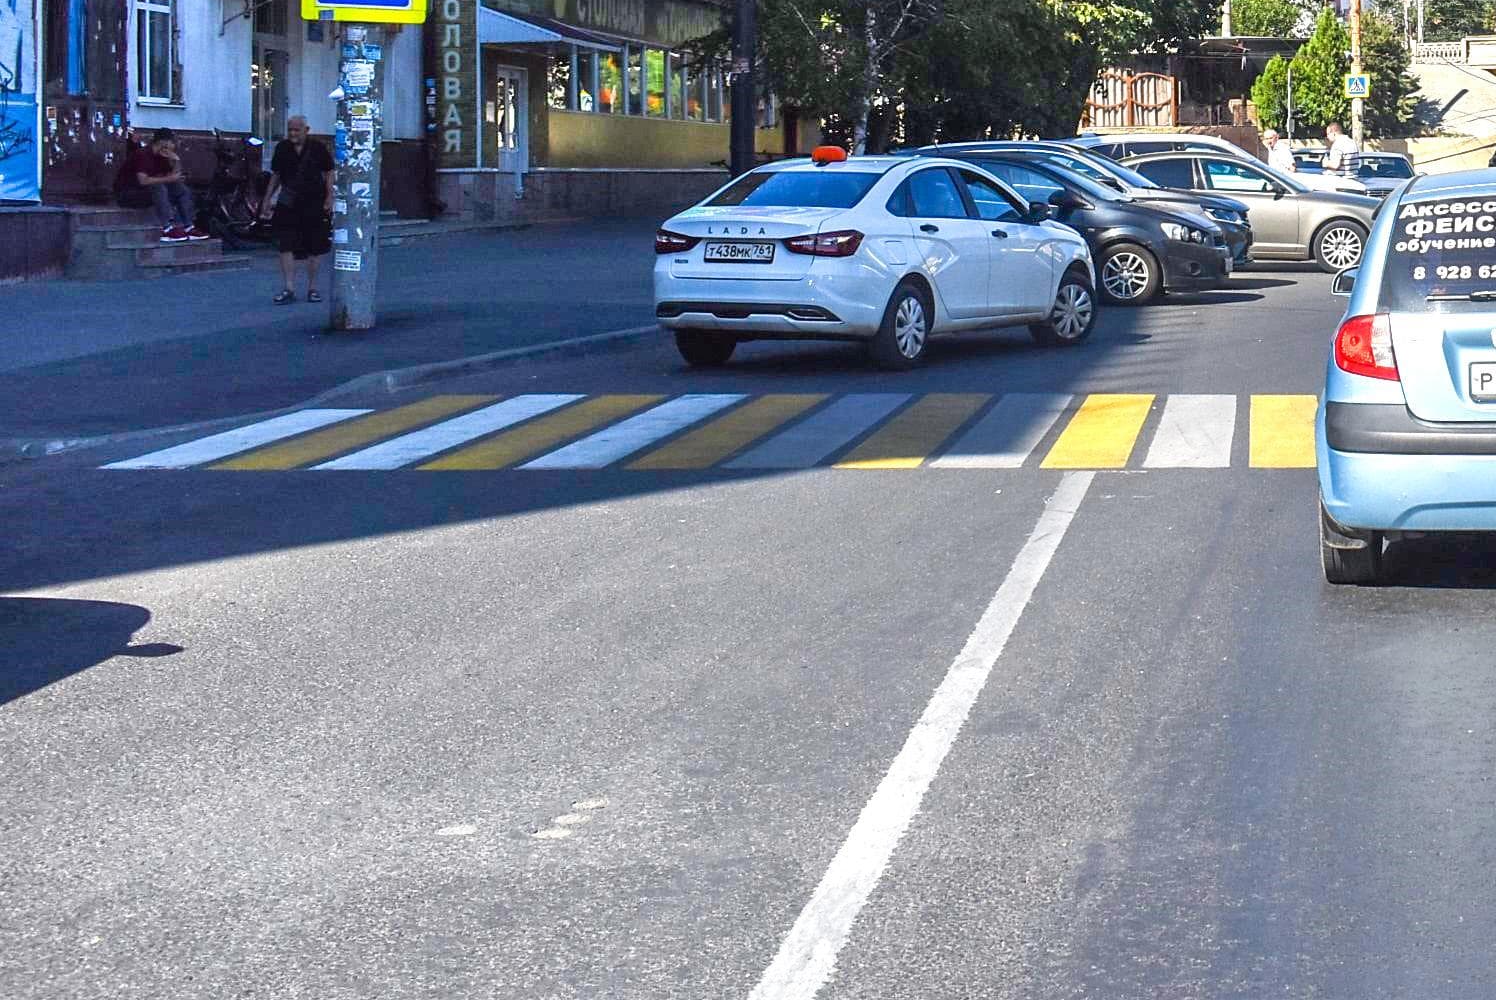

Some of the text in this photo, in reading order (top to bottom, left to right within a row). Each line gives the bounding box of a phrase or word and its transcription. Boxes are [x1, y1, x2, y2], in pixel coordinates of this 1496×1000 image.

[708, 227, 766, 236] LADA
[1395, 238, 1496, 252] обучение
[1413, 267, 1426, 280] 8
[1436, 265, 1472, 280] 928
